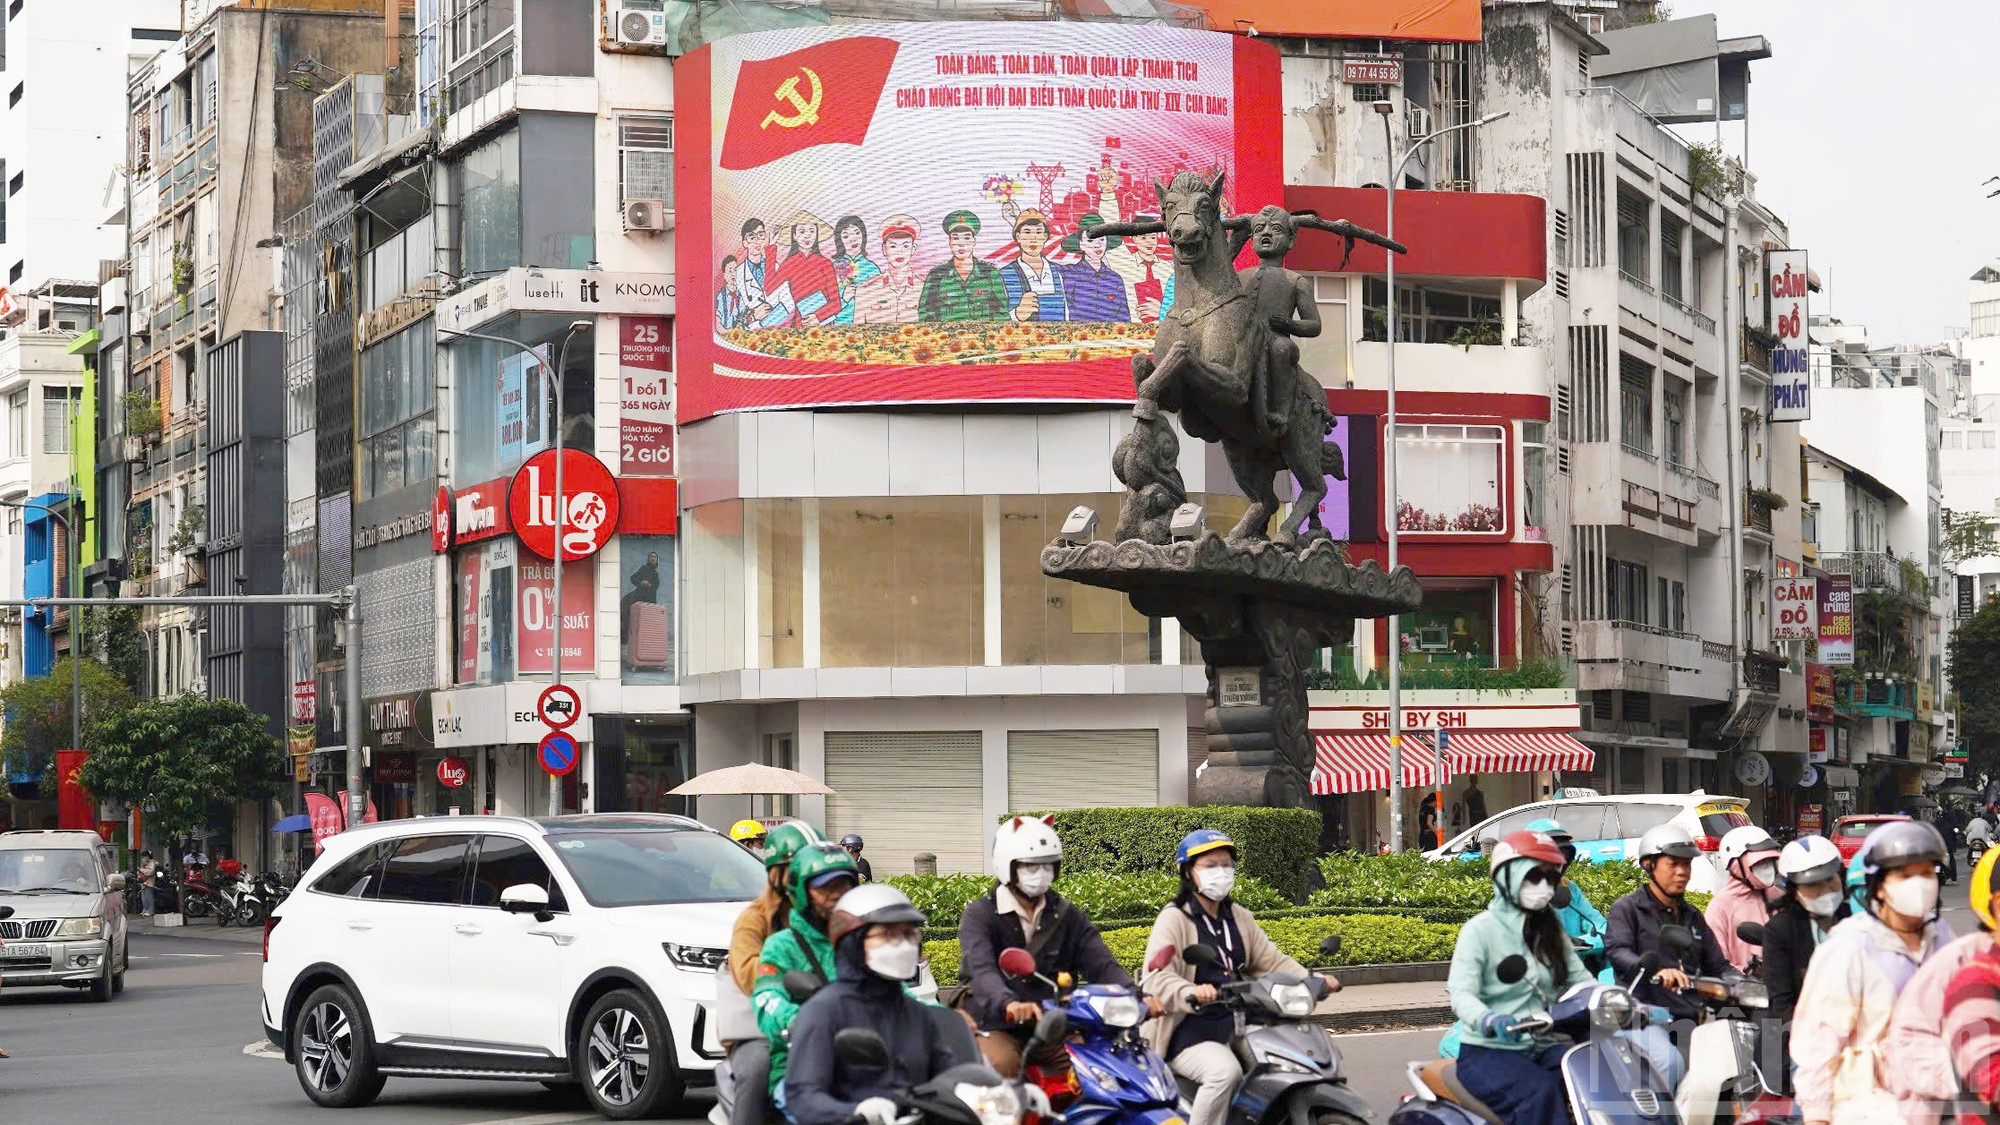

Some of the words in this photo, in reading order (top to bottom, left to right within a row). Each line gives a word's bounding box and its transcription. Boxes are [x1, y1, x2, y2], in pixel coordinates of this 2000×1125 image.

[935, 52, 963, 75] TOÀN
[1001, 52, 1029, 75] TOÀN
[1060, 52, 1087, 75] TOÀN
[1091, 54, 1118, 78] QUÂN
[1121, 54, 1139, 80] LẬP
[1142, 57, 1174, 80] THÀNH
[1347, 67, 1357, 79] 09
[1358, 67, 1367, 78] 77
[1368, 67, 1378, 79] 44
[1379, 68, 1388, 79] 55
[1389, 67, 1399, 80] 88
[896, 85, 925, 108] CHÀO
[929, 84, 961, 107] MỪNG
[964, 86, 982, 110] ĐẠI
[986, 83, 1005, 110] HỘI
[1030, 80, 1054, 107] BIỂU
[1057, 84, 1085, 107] TOÀN
[1088, 83, 1116, 110] QUỐC
[1119, 83, 1137, 109] LẦN
[1164, 92, 1182, 112] XIV
[1771, 262, 1806, 298] CẦM
[1778, 302, 1801, 339] ĐỒ
[634, 324, 659, 343] 25
[625, 377, 633, 395] 1
[658, 378, 667, 395] 1
[1773, 378, 1808, 409] PHÁT
[621, 401, 640, 410] 365
[642, 399, 671, 411] NGÀY
[622, 425, 642, 433] GIAO
[642, 425, 664, 434] HÀNG
[622, 443, 635, 462] 2
[638, 445, 671, 463] GIỜ
[526, 466, 607, 555] lug
[521, 561, 542, 580] TRẢ
[1774, 579, 1814, 601] CẦM
[1829, 591, 1850, 602] cafe
[563, 611, 590, 629] SUẤT
[1780, 602, 1808, 624] ĐỒ
[1833, 615, 1851, 626] egg
[1774, 627, 1795, 639] 2.5%
[1801, 627, 1814, 639] 3%
[1821, 625, 1851, 636] coffee
[384, 699, 410, 729] THANH
[1406, 712, 1431, 727] BY
[1437, 711, 1466, 727] SHI
[443, 762, 466, 786] lug
